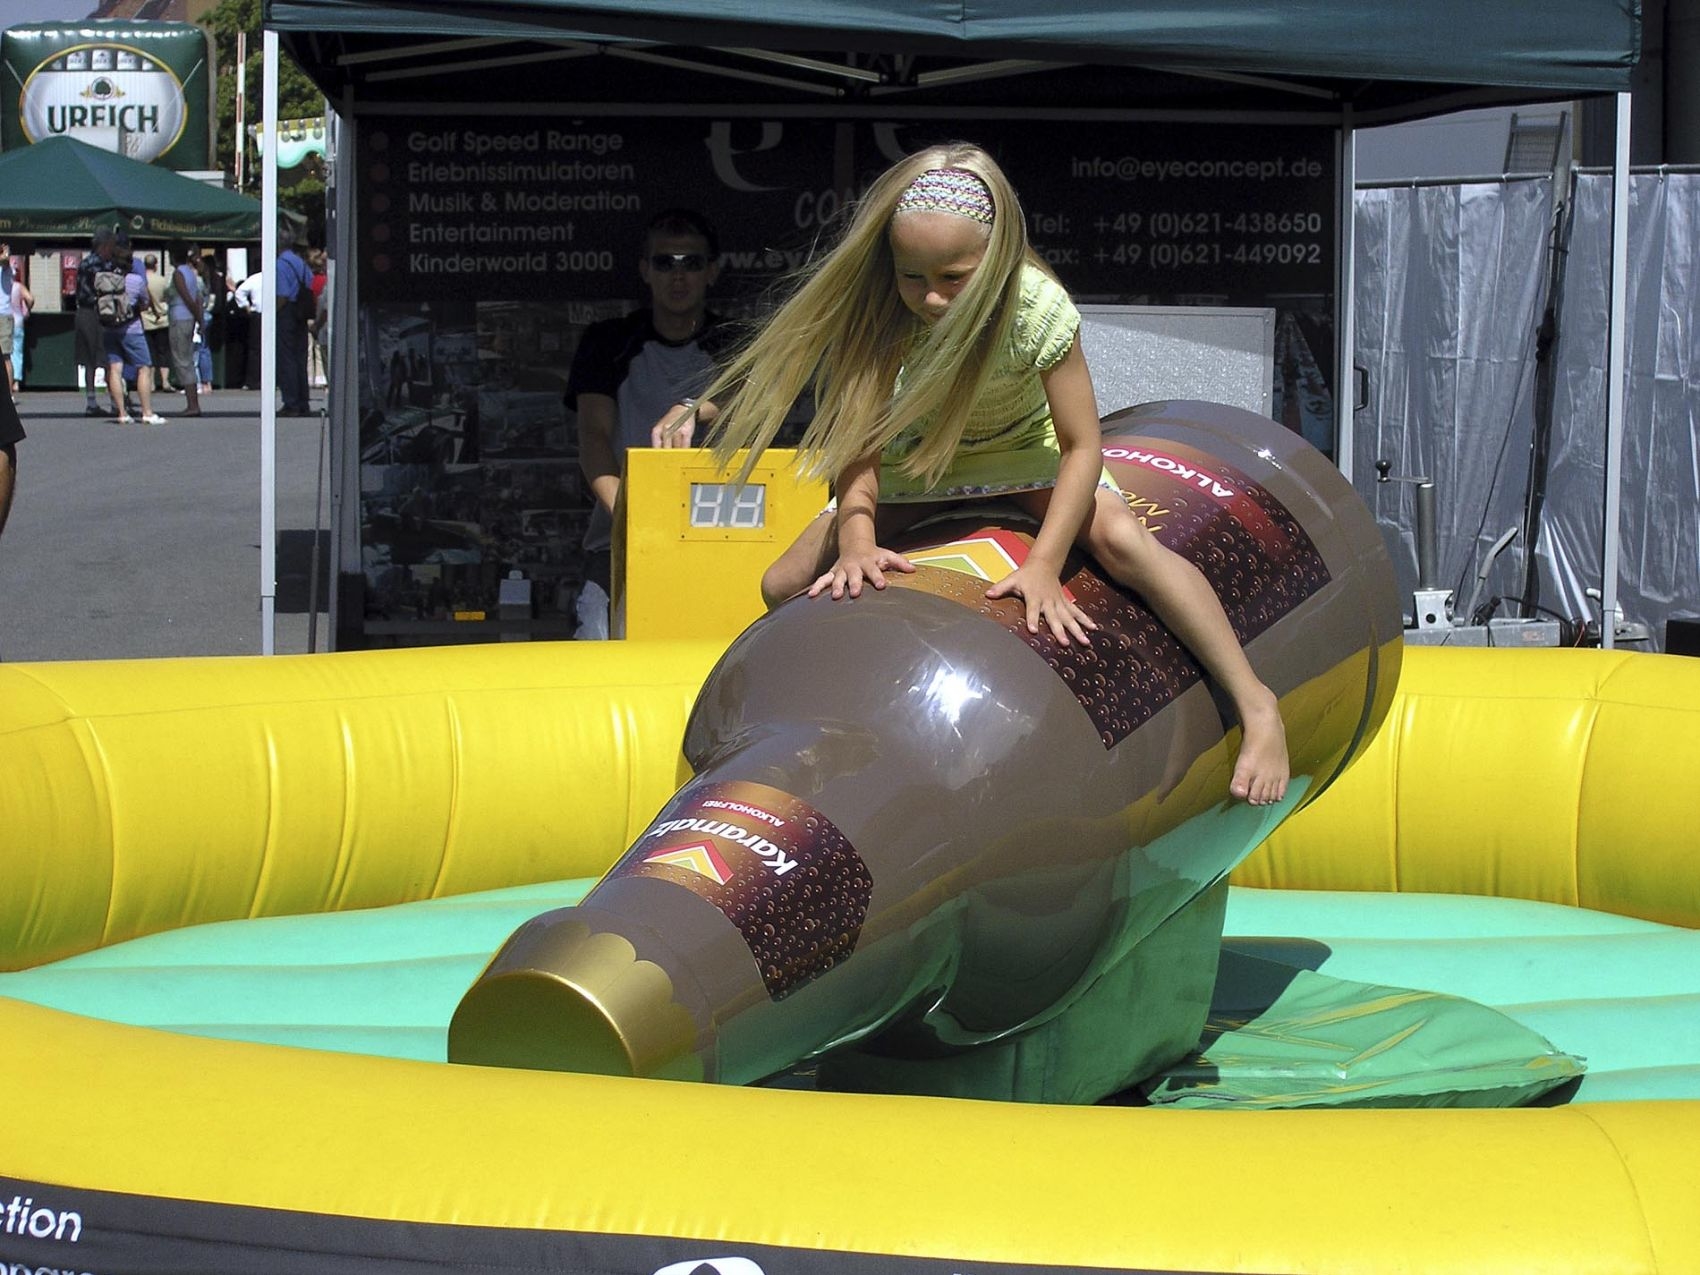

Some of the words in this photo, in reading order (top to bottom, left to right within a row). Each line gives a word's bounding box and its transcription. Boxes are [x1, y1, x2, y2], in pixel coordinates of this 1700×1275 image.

[407, 131, 458, 153] Golf
[463, 130, 539, 155] Speed
[546, 130, 624, 156] Range
[407, 160, 635, 183] Erlebnissimulatoren
[1071, 156, 1323, 182] info@eyeconcept.de
[408, 191, 474, 213] Musik
[480, 191, 498, 212] &
[504, 190, 641, 212] Moderation
[409, 221, 575, 243] Entertainment
[1031, 213, 1071, 234] Tel:
[1093, 212, 1142, 234] +49
[1149, 212, 1322, 239] (0)621-438650
[409, 251, 548, 273] Kinderworld
[555, 250, 613, 271] 3000
[1093, 243, 1142, 265] +49
[1149, 243, 1322, 269] (0)621-449092
[1101, 447, 1234, 498] ALKOHO
[701, 799, 785, 828] ALKOHOLFREI
[646, 817, 799, 877] Karamalz
